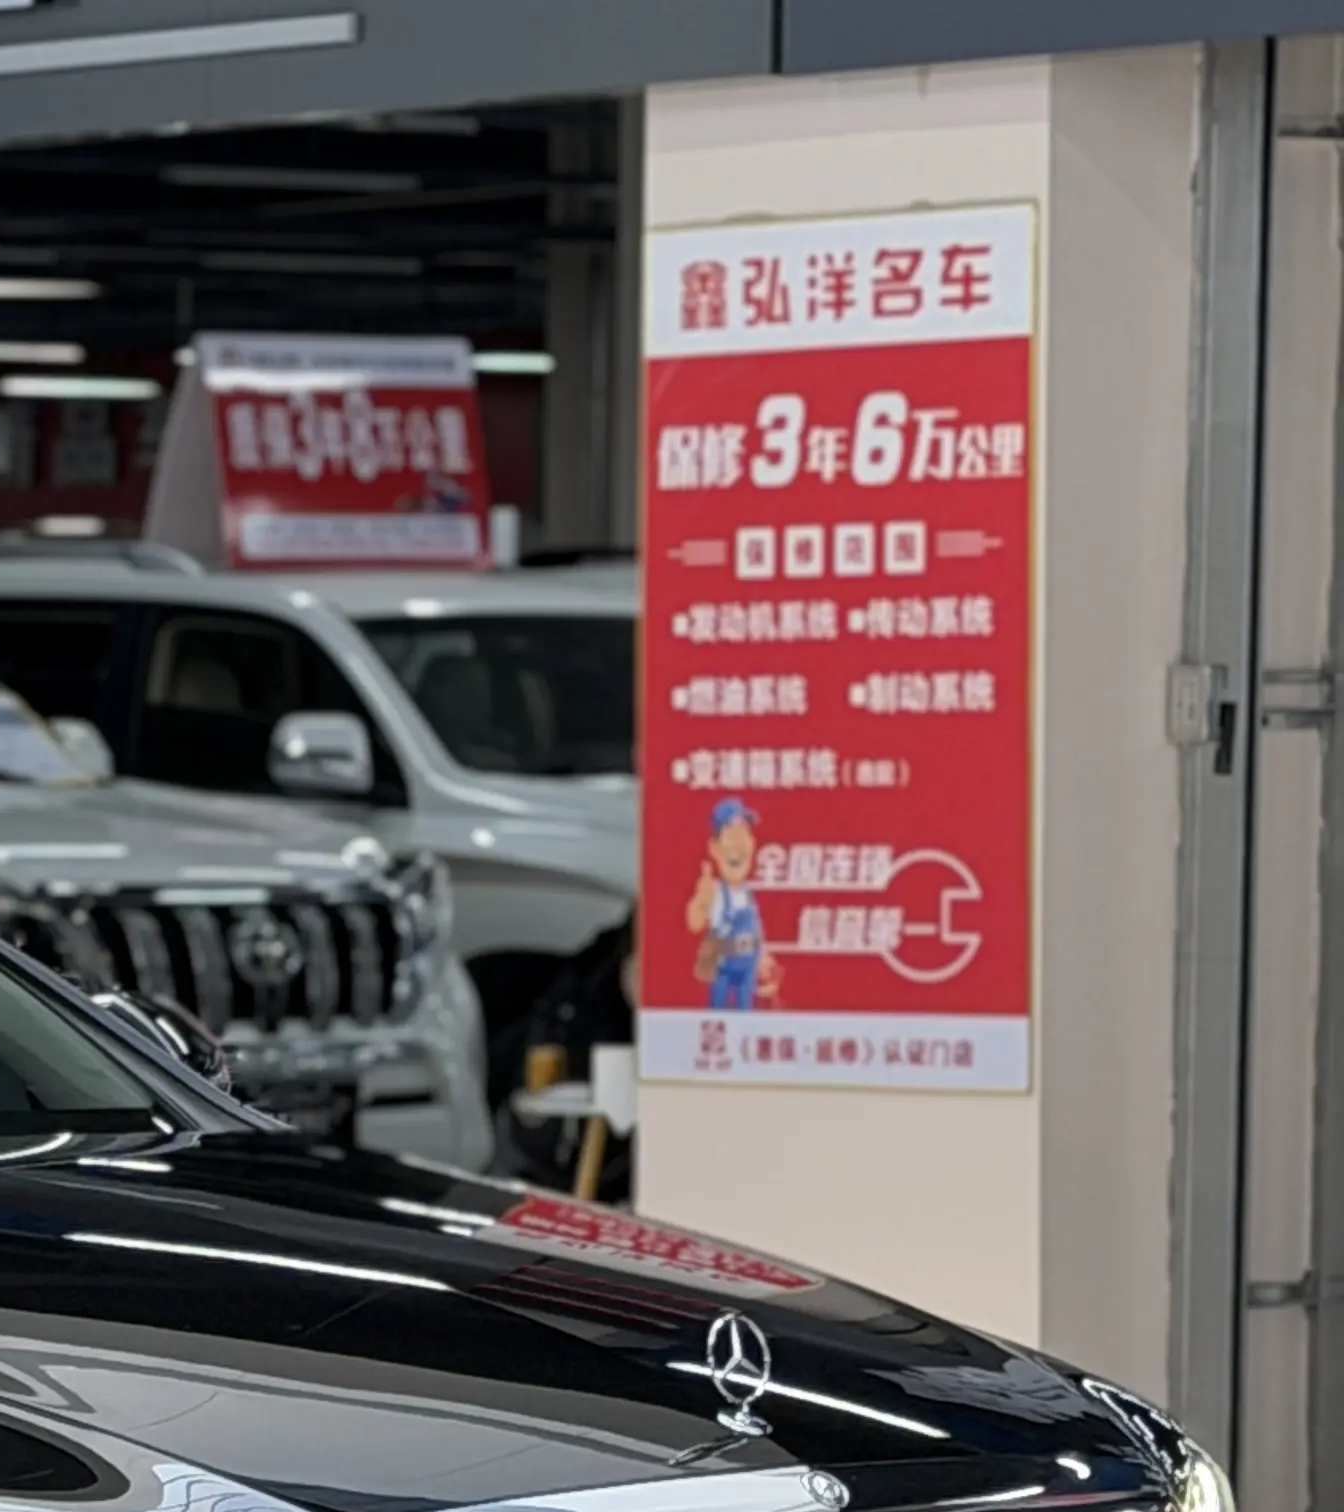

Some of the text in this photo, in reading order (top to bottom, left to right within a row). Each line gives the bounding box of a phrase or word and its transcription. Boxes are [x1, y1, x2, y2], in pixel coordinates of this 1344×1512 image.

[678, 243, 993, 331] 鑫弘洋名车
[656, 389, 1025, 491] 保修3年6万公里
